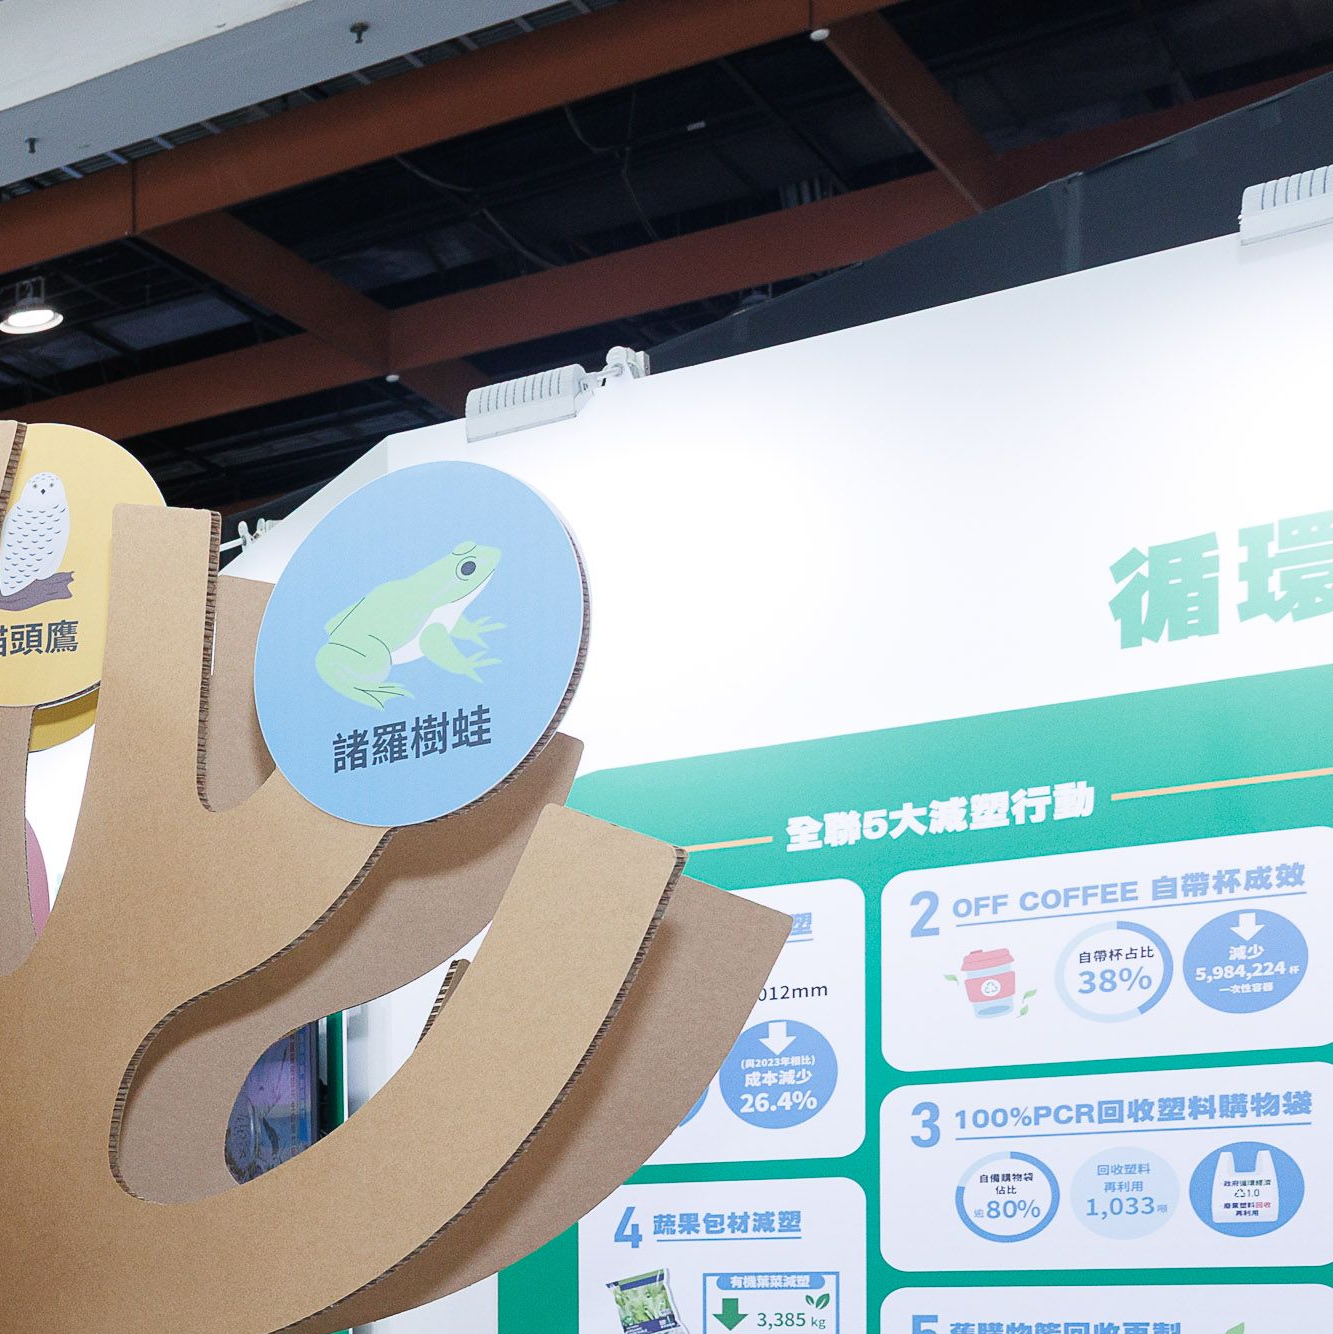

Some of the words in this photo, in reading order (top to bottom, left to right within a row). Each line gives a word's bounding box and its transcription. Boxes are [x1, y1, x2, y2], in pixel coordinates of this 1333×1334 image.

[330, 702, 493, 774] 諸羅樹蛙
[786, 781, 1095, 852] 全聯5大減塑行動
[910, 891, 940, 938] 2
[953, 895, 1008, 918] OFF
[1019, 881, 1139, 911] COFFEE
[1151, 862, 1305, 901] 自帶杯成效
[1079, 946, 1154, 965] 自帶杯占比
[1229, 944, 1264, 961] 減少
[1078, 967, 1152, 994] 38%
[1195, 961, 1286, 984] 5,984,224
[744, 1069, 813, 1087] 成本減少
[740, 1090, 818, 1114] 26.4%
[911, 1101, 940, 1148] 3
[955, 1090, 1312, 1130] 100%PCR回收塑料購物袋
[1097, 1163, 1151, 1176] 回收塑料
[1104, 1181, 1144, 1192] 再利用
[986, 1199, 1041, 1219] 80%
[1086, 1197, 1155, 1220] 1,033
[614, 1206, 642, 1248] 4
[653, 1211, 801, 1235] 蔬果包材減塑
[757, 1312, 806, 1330] 3,385
[811, 1317, 826, 1329] kg
